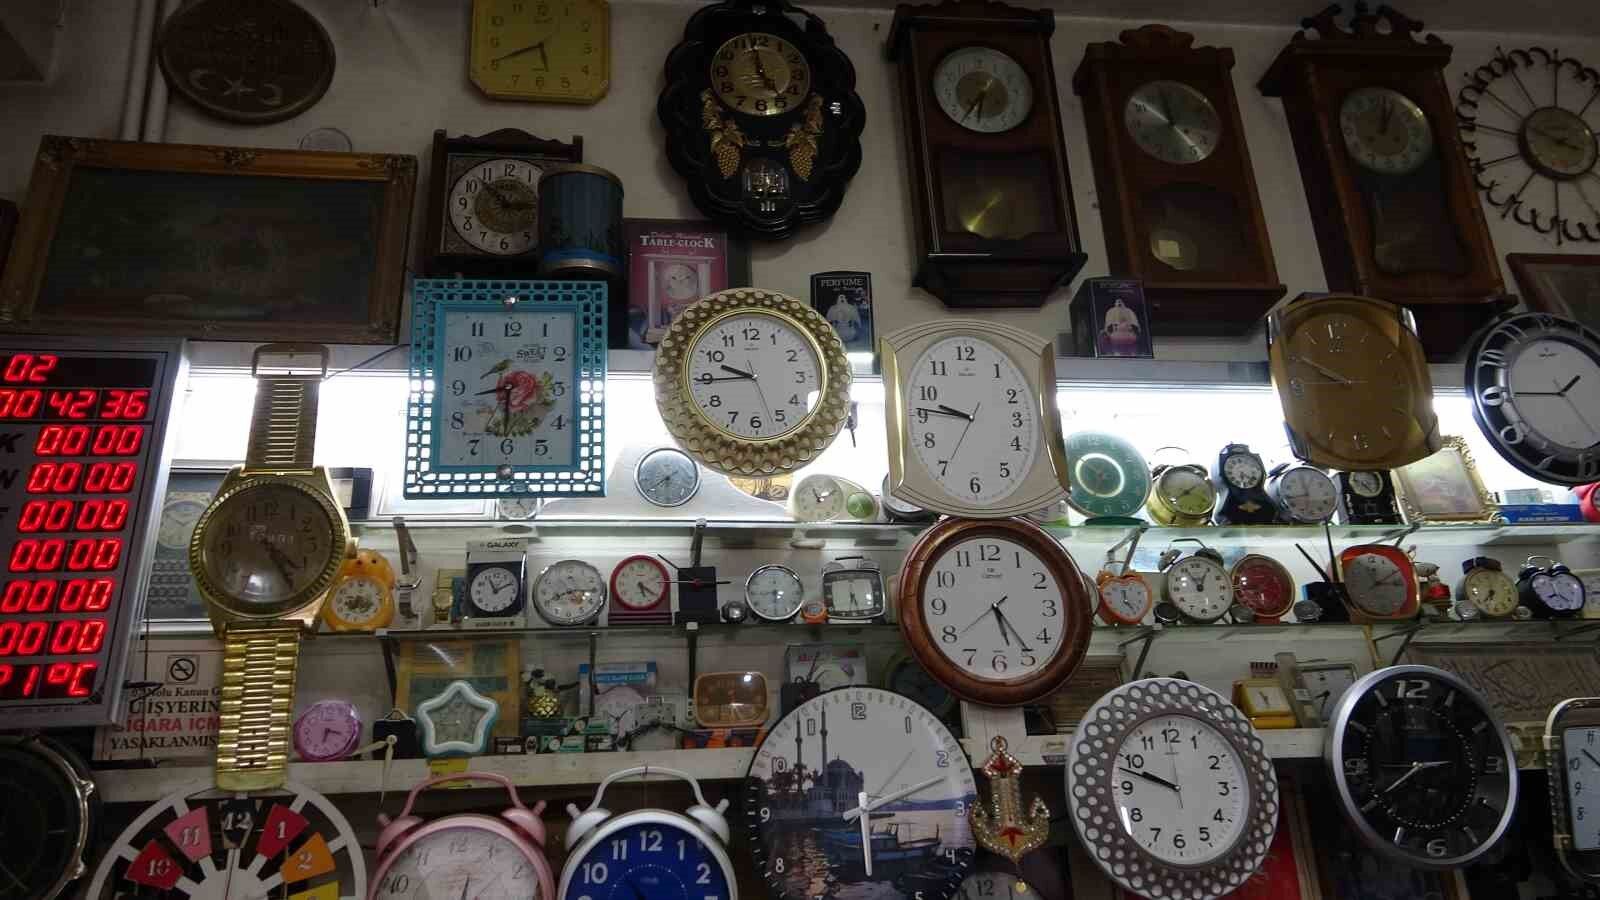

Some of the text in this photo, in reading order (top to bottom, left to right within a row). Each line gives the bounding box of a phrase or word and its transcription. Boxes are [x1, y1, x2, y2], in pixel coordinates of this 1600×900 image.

[470, 321, 484, 338] 11
[503, 321, 523, 338] 12
[542, 322, 549, 338] 1
[741, 328, 761, 341] 12
[721, 334, 735, 347] 11
[769, 333, 777, 346] 1
[453, 344, 473, 363] 10
[552, 346, 567, 363] 2
[705, 350, 725, 363] 10
[786, 349, 799, 363] 2
[955, 345, 977, 361] 12
[4, 354, 60, 383] 02
[929, 360, 948, 376] 11
[993, 363, 1001, 379] 1
[701, 372, 714, 385] 9
[794, 371, 806, 384] 3
[451, 379, 466, 397] 9
[919, 385, 938, 401] 10
[1006, 388, 1019, 404] 2
[49, 390, 98, 419] 42
[100, 390, 150, 420] 36
[709, 394, 722, 408] 8
[788, 393, 801, 407] 4
[450, 410, 465, 431] 8
[549, 413, 566, 431] 4
[727, 411, 740, 424] 7
[749, 415, 762, 429] 6
[774, 409, 786, 422] 5
[917, 408, 929, 424] 9
[1011, 411, 1023, 428] 3
[467, 439, 480, 456] 7
[499, 438, 514, 456] 6
[533, 439, 549, 456] 5
[924, 432, 936, 449] 8
[1009, 435, 1021, 451] 4
[937, 460, 949, 477] 7
[999, 462, 1010, 478] 5
[969, 476, 981, 494] 6
[955, 550, 971, 568] 11
[978, 544, 1001, 562] 12
[1015, 551, 1023, 569] 1
[936, 570, 956, 589] 10
[1031, 571, 1047, 590] 2
[930, 598, 947, 616] 9
[1041, 599, 1057, 618] 3
[941, 624, 958, 644] 8
[1035, 627, 1052, 645] 4
[961, 648, 977, 667] 7
[991, 654, 1008, 673] 6
[1020, 648, 1037, 667] 5
[1393, 679, 1431, 699] 12
[1141, 736, 1154, 751] 11
[1160, 729, 1181, 743] 12
[1190, 735, 1198, 750] 1
[1124, 754, 1144, 769] 10
[1207, 755, 1221, 770] 2
[1121, 780, 1134, 796] 9
[1217, 781, 1230, 797] 3
[223, 811, 250, 831] 12
[759, 807, 771, 824] 9
[1130, 807, 1143, 823] 8
[1212, 807, 1226, 823] 4
[180, 827, 201, 847] 11
[276, 820, 287, 840] 1
[1149, 827, 1162, 842] 7
[1198, 826, 1210, 842] 5
[611, 838, 628, 861] 11
[639, 829, 664, 853] 12
[1173, 834, 1187, 849] 6
[1426, 838, 1447, 858] 6
[676, 838, 686, 862] 1
[146, 859, 170, 878] 10
[298, 850, 314, 871] 2
[774, 856, 785, 874] 8
[582, 861, 609, 885] 10
[695, 862, 712, 885] 2
